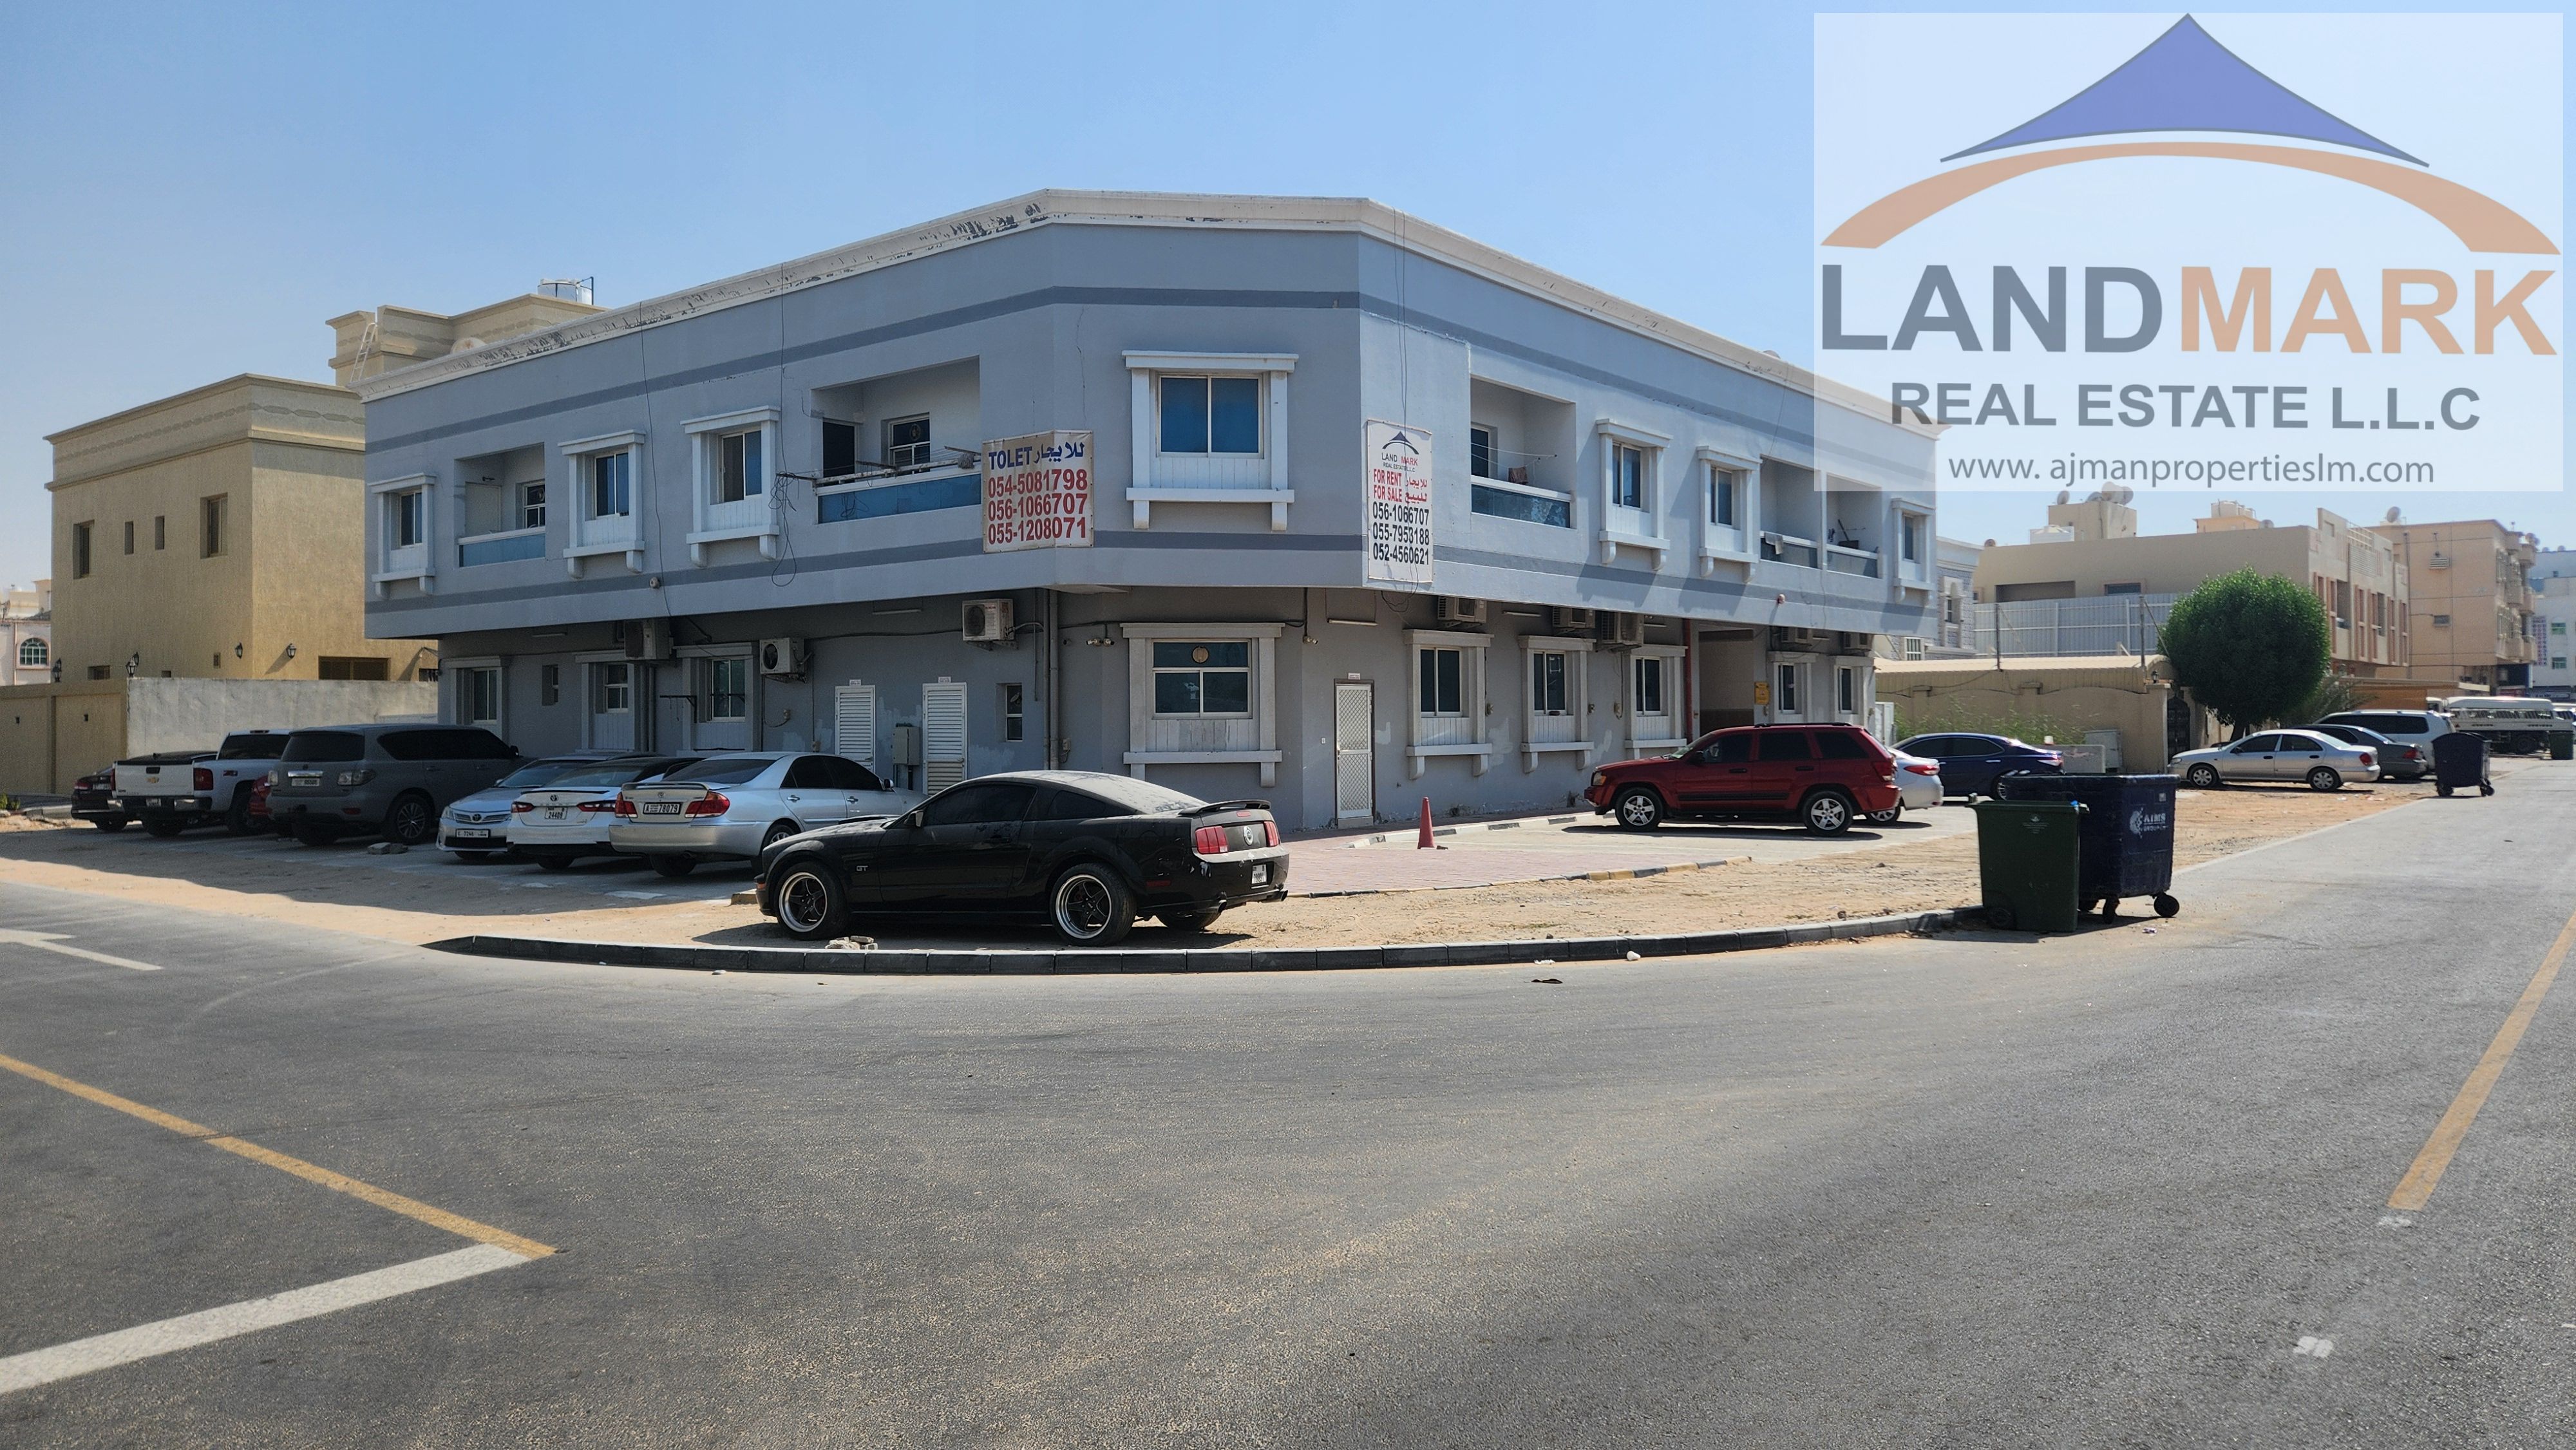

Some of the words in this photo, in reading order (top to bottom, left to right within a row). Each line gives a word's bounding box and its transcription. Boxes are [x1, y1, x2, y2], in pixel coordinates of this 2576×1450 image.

[989, 447, 1032, 470] TOLET
[1381, 452, 1397, 462] LAND
[1401, 456, 1418, 466] MARK
[989, 469, 1088, 498] 054-5081798
[1374, 469, 1385, 484] FOR
[1387, 471, 1402, 486] RENT
[1374, 485, 1386, 500] FOR
[1387, 487, 1402, 502] SALE
[989, 493, 1088, 522] 056-1066707
[1373, 502, 1429, 525] 056-1066707
[989, 517, 1086, 545] 055-1208071
[1373, 522, 1429, 545] 055-7953188
[1373, 542, 1429, 565] 052-4560621
